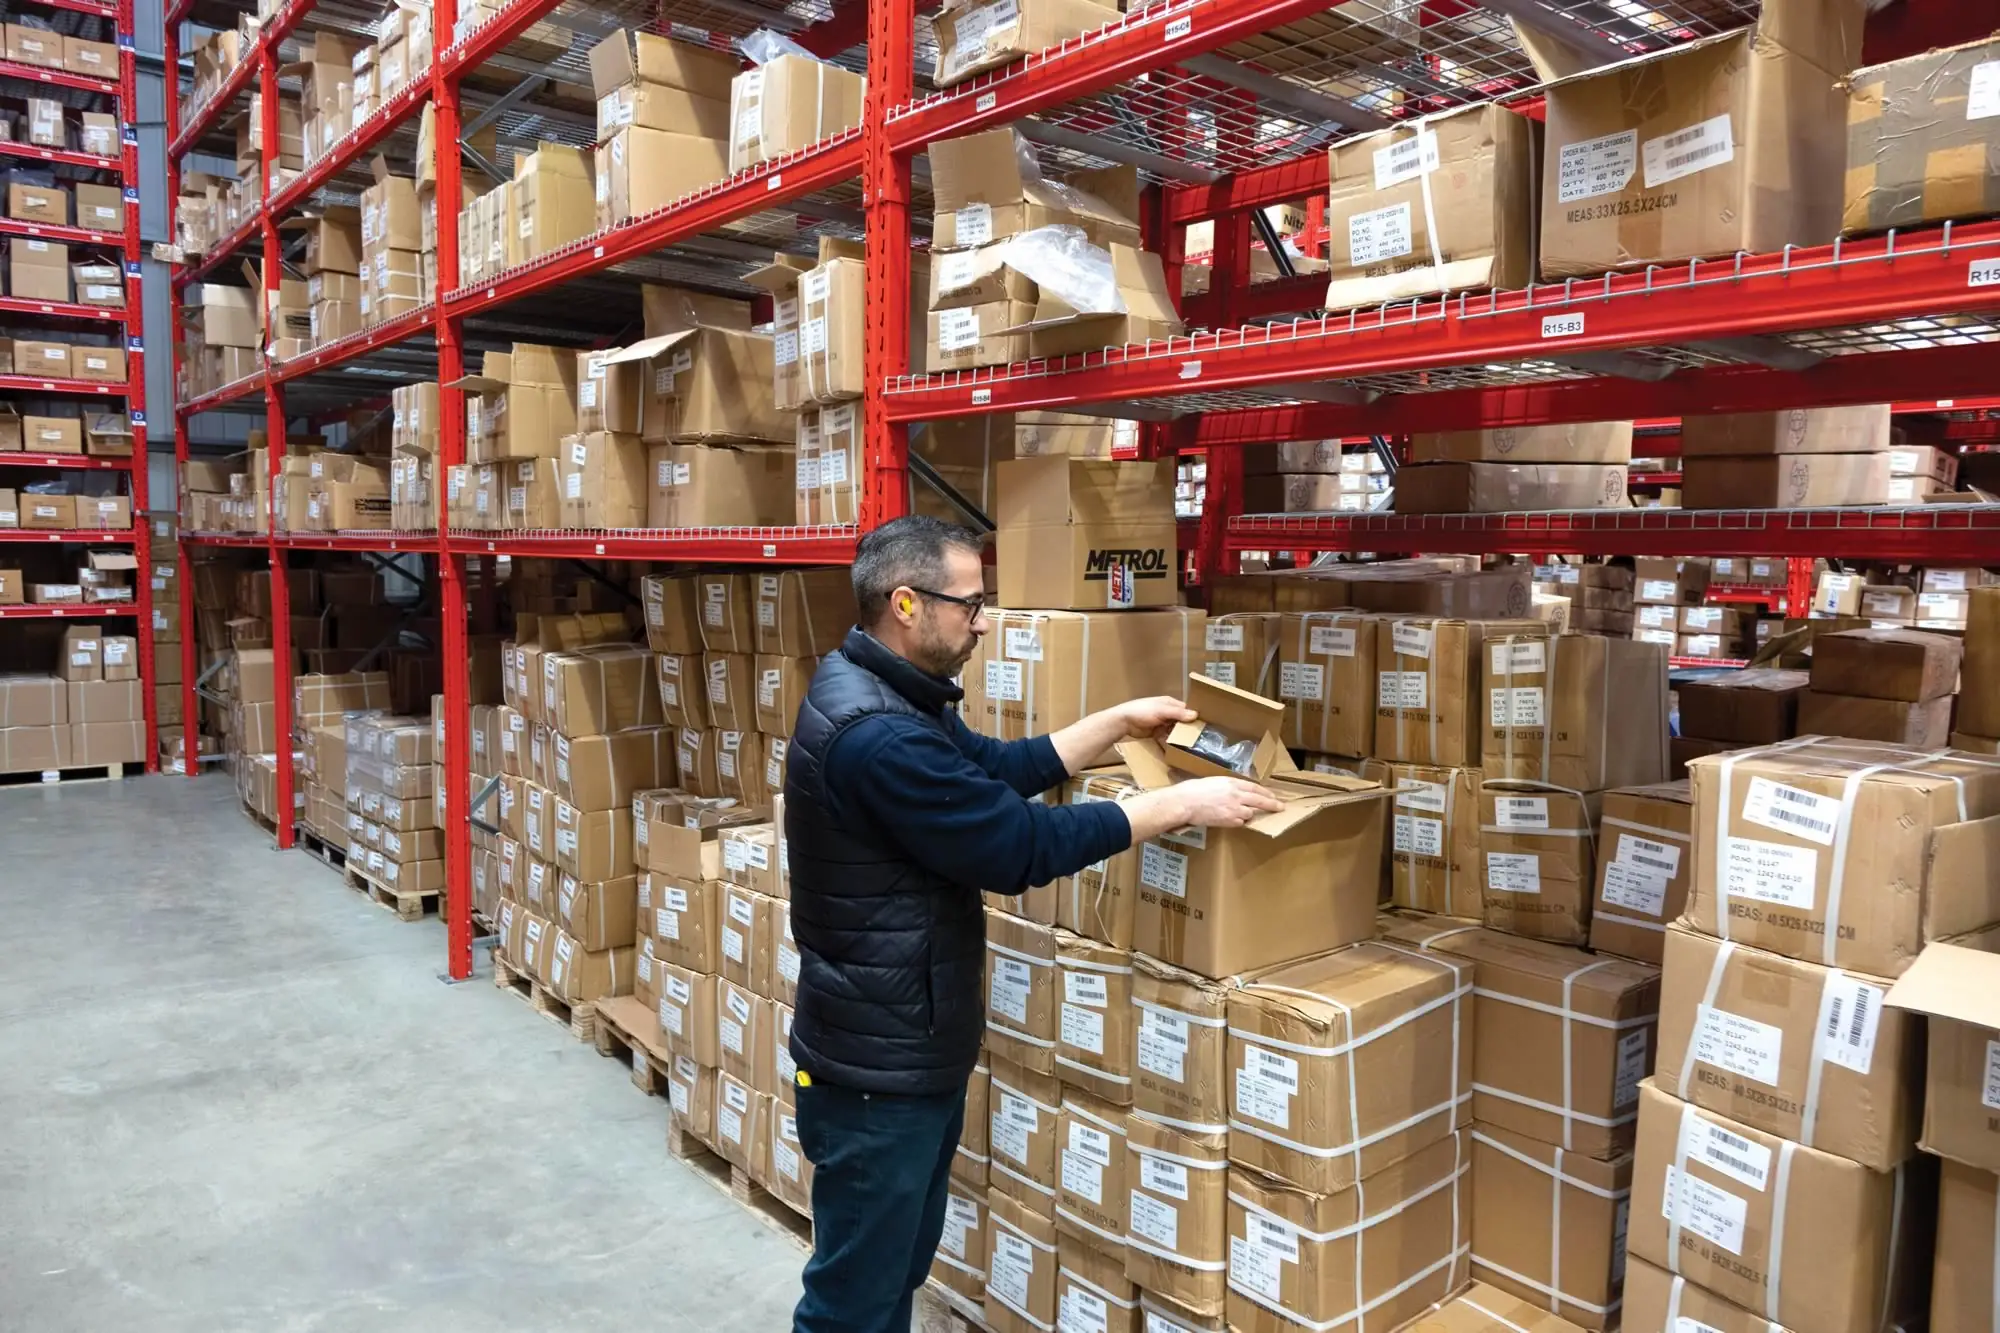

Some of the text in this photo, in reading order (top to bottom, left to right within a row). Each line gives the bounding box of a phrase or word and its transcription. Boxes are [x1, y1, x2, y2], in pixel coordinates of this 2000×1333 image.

[1612, 168, 1625, 178] PCS
[127, 188, 136, 196] G
[130, 263, 138, 272] F
[1543, 321, 1581, 334] R15-B3
[132, 338, 140, 346] E
[135, 411, 143, 420] D
[1086, 549, 1168, 571] METROL
[1836, 924, 1856, 940] CM
